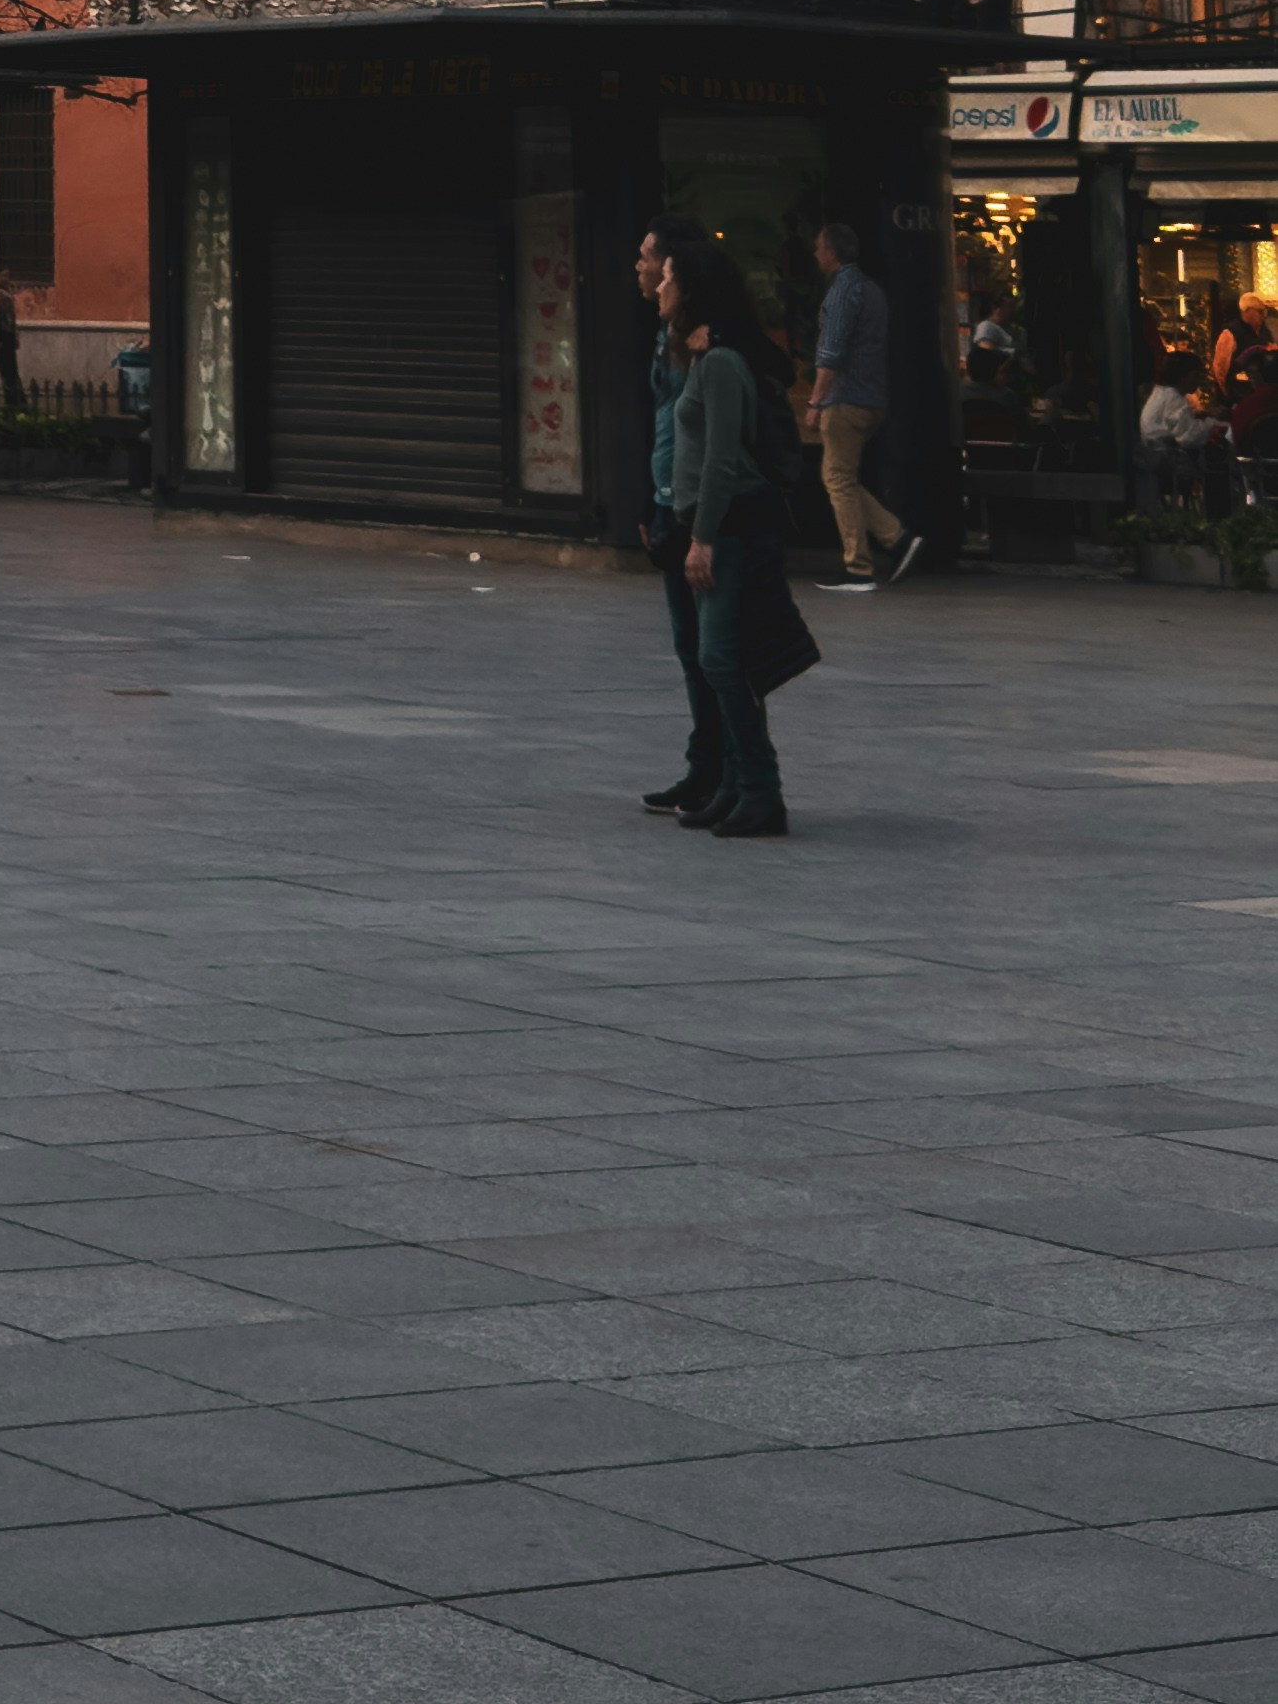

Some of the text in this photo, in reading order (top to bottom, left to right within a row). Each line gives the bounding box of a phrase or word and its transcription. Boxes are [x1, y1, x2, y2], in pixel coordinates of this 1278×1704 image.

[951, 105, 1016, 129] pepsi
[1094, 97, 1182, 121] EL LAUREL
